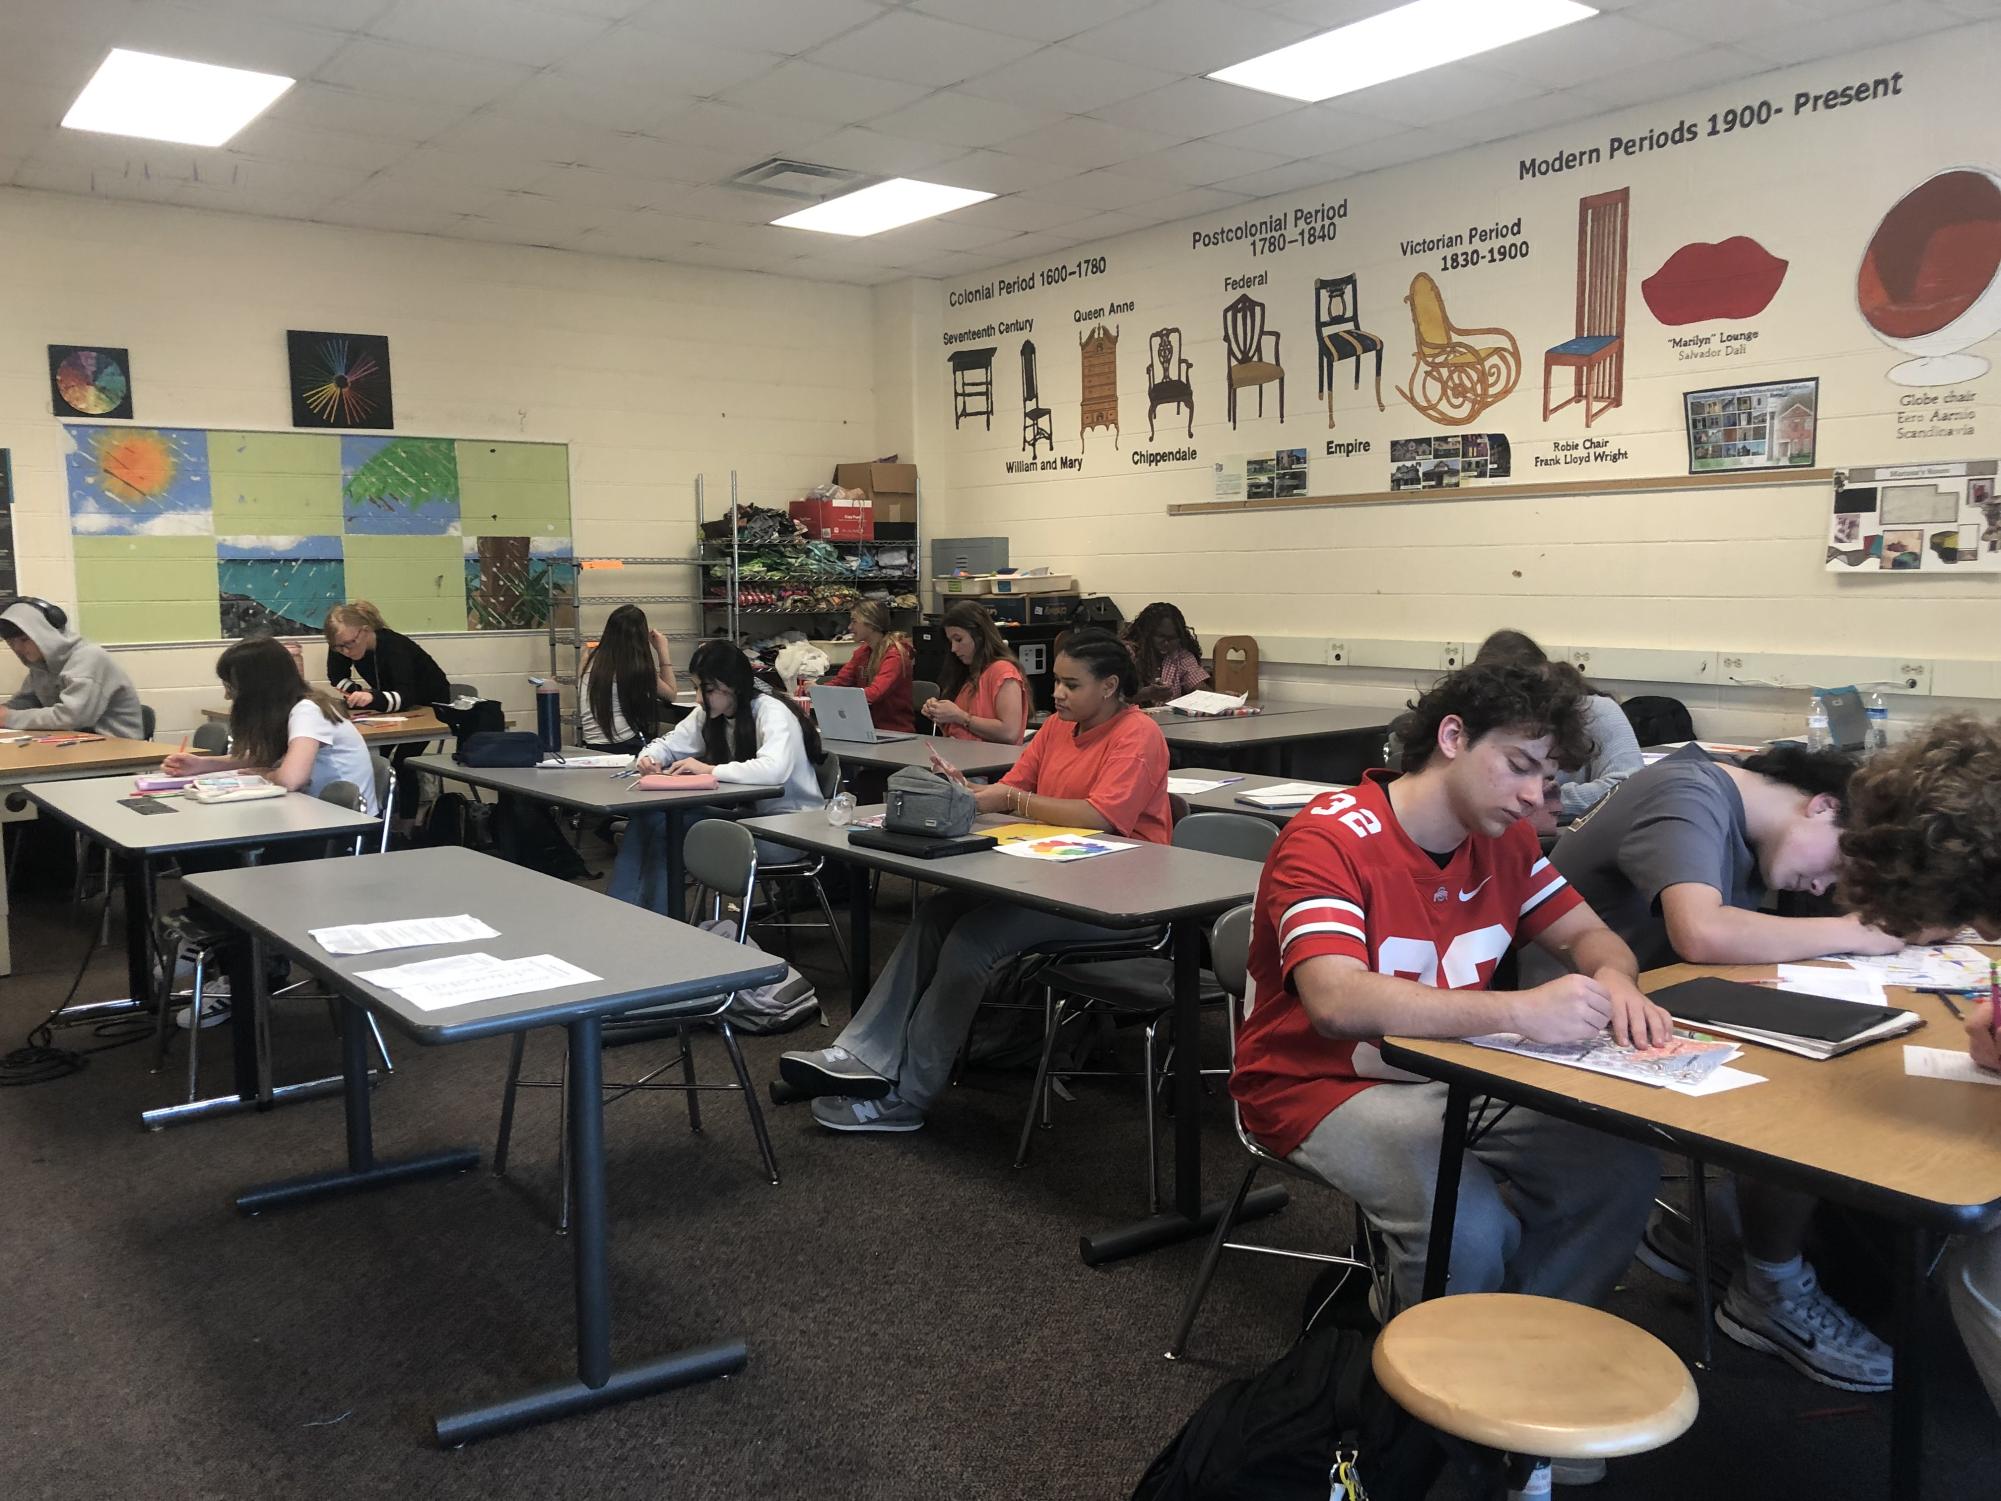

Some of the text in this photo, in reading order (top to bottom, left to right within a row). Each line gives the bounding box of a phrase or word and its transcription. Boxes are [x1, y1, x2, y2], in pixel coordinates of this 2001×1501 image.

[1518, 71, 1904, 180] Modern Periods 1900- Present
[1192, 198, 1349, 250] Postcolonial Period
[1400, 217, 1522, 257] Victorian Period
[1440, 240, 1530, 272] 1830-1900
[949, 281, 995, 308] Colonial
[998, 271, 1036, 296] Period
[1223, 270, 1268, 292] Federal
[1073, 300, 1135, 324] Queen Anne
[943, 318, 1035, 346] Seventeenth Century
[1719, 330, 1760, 344] Lounge
[1678, 347, 1722, 361] Salvador
[1899, 392, 1940, 407] Globe
[1325, 438, 1372, 458] Empire
[1553, 438, 1610, 452] Robie Chair
[1006, 454, 1084, 474] William and Mary
[1131, 446, 1198, 468] Chippendale
[1534, 448, 1629, 467] Frank Lloyd Wright
[1310, 792, 1382, 838] 32
